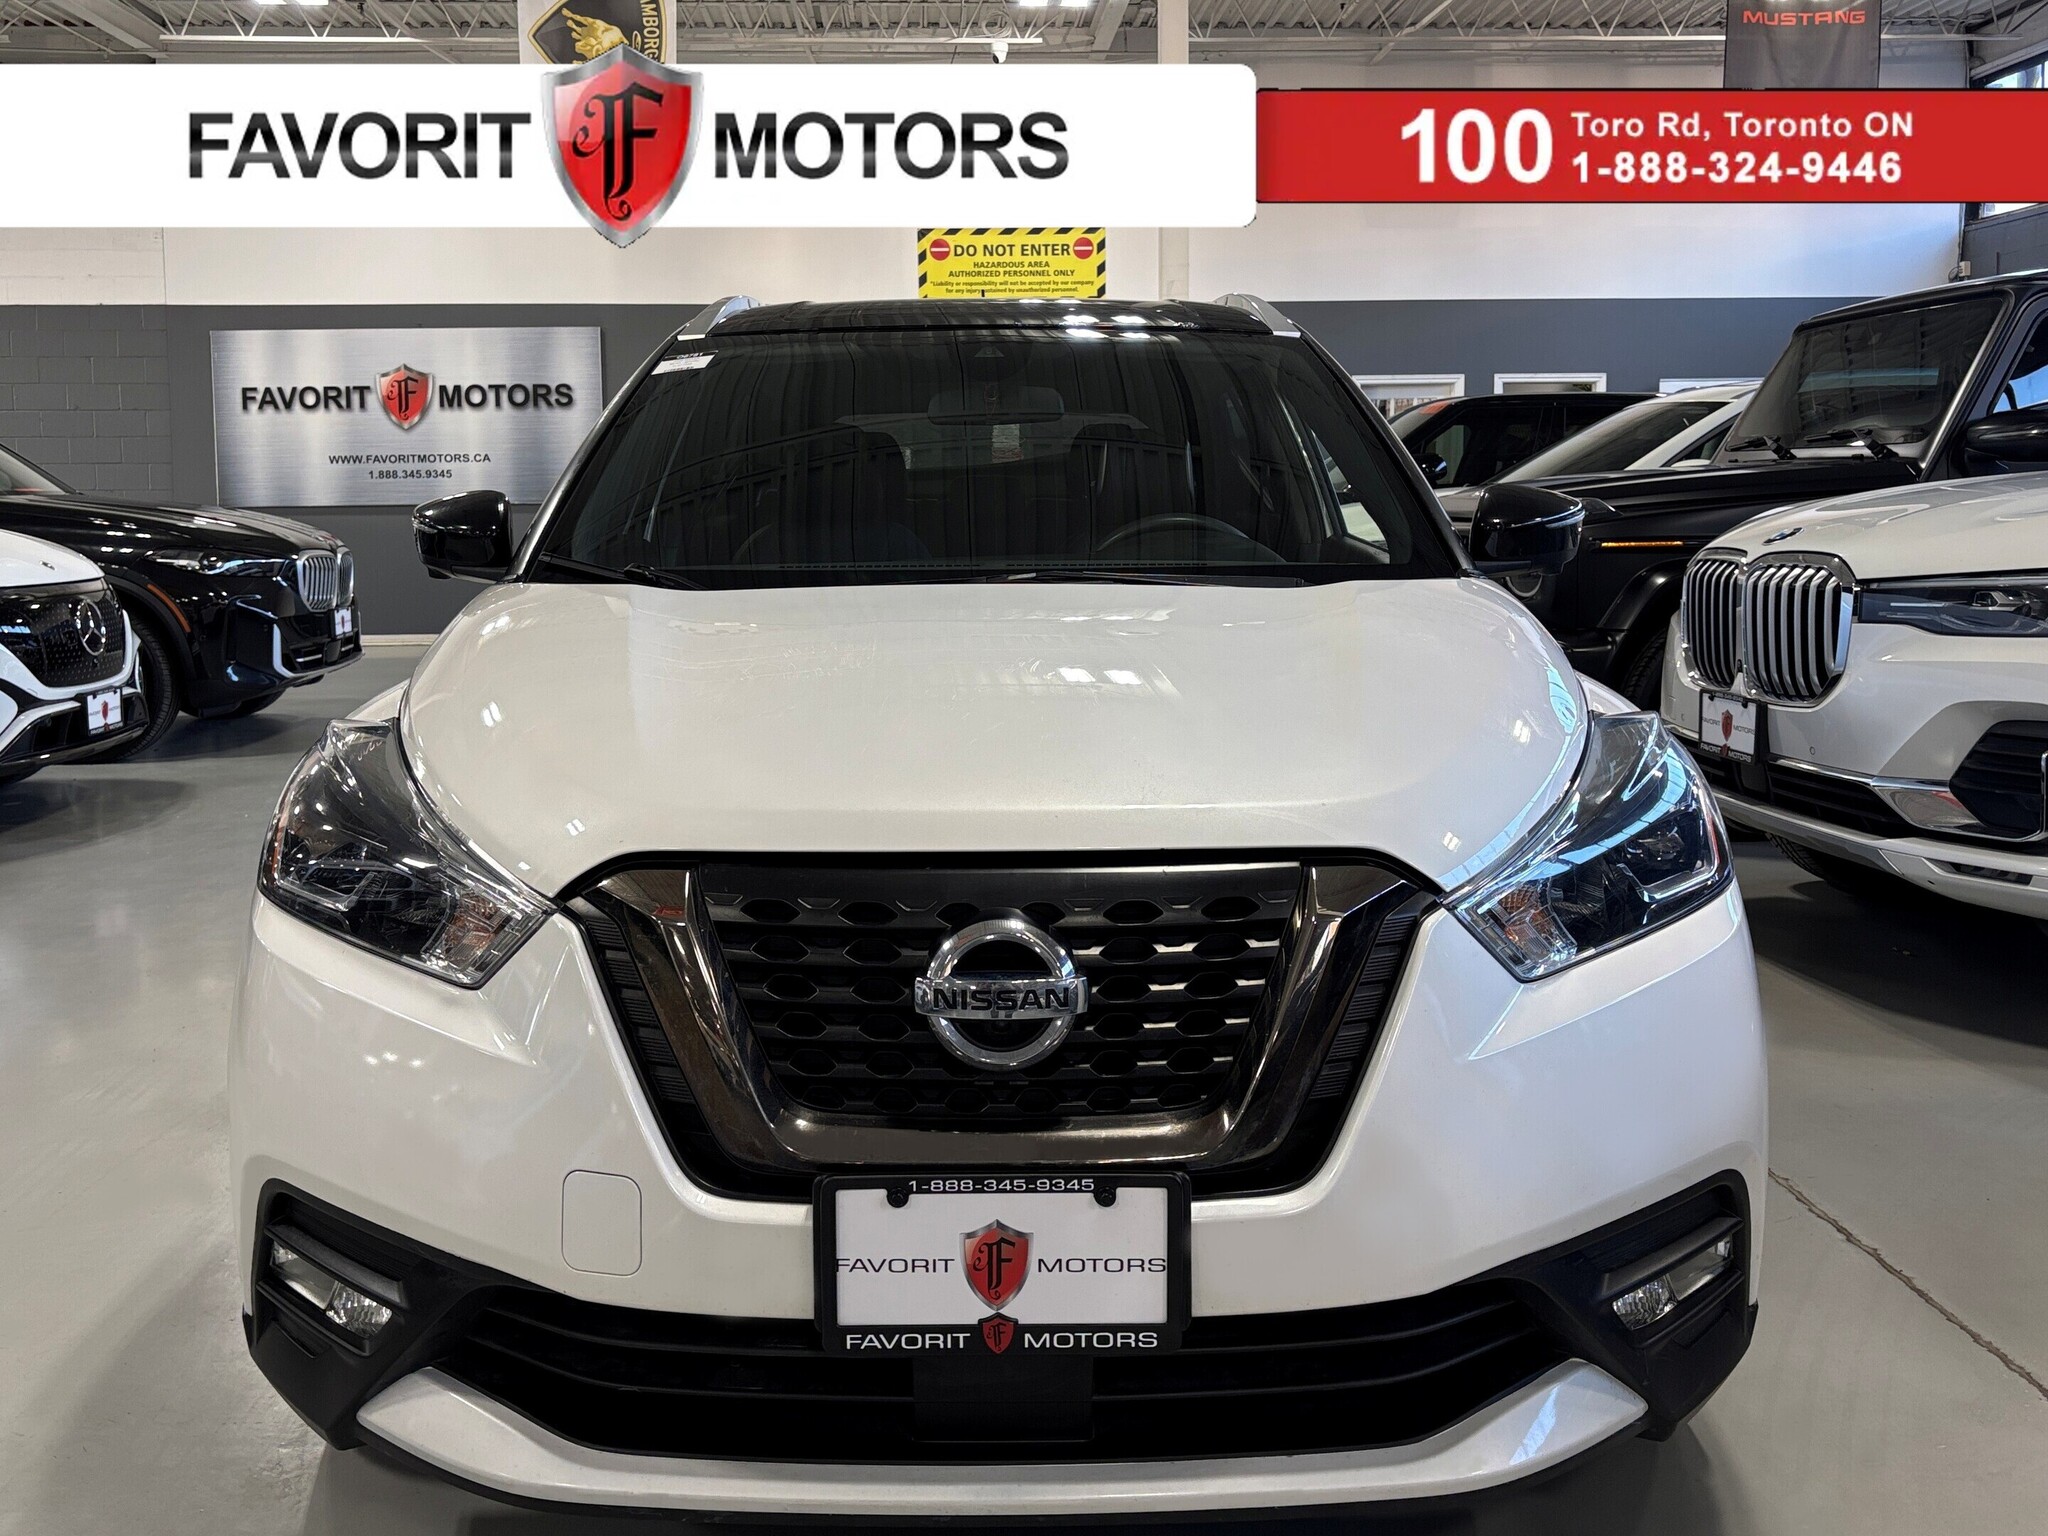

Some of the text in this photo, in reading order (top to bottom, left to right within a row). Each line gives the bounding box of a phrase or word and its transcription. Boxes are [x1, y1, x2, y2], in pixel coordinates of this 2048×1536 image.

[1743, 10, 1865, 26] MUSTANG
[954, 243, 1070, 257] DO NOT ENTER
[973, 260, 1050, 269] HAZARDOUS AREA
[948, 269, 1075, 278] AUTHORIZED PERSONNEL ONLY
[962, 280, 998, 288] responsibility
[242, 385, 371, 410] FAVORIT
[439, 383, 574, 409] MOTORS
[328, 453, 491, 464] WWW.FAVORITMOTORS.CA
[368, 469, 453, 480] 1.888.345.9345
[933, 987, 1069, 1010] NISSAN
[908, 1179, 1095, 1192] 1-888-345-9345
[836, 1258, 955, 1273] FAVORIT
[1038, 1258, 1167, 1273] MOTORS
[846, 1333, 971, 1350] FAVORIT
[1024, 1332, 1158, 1349] MOTORS
